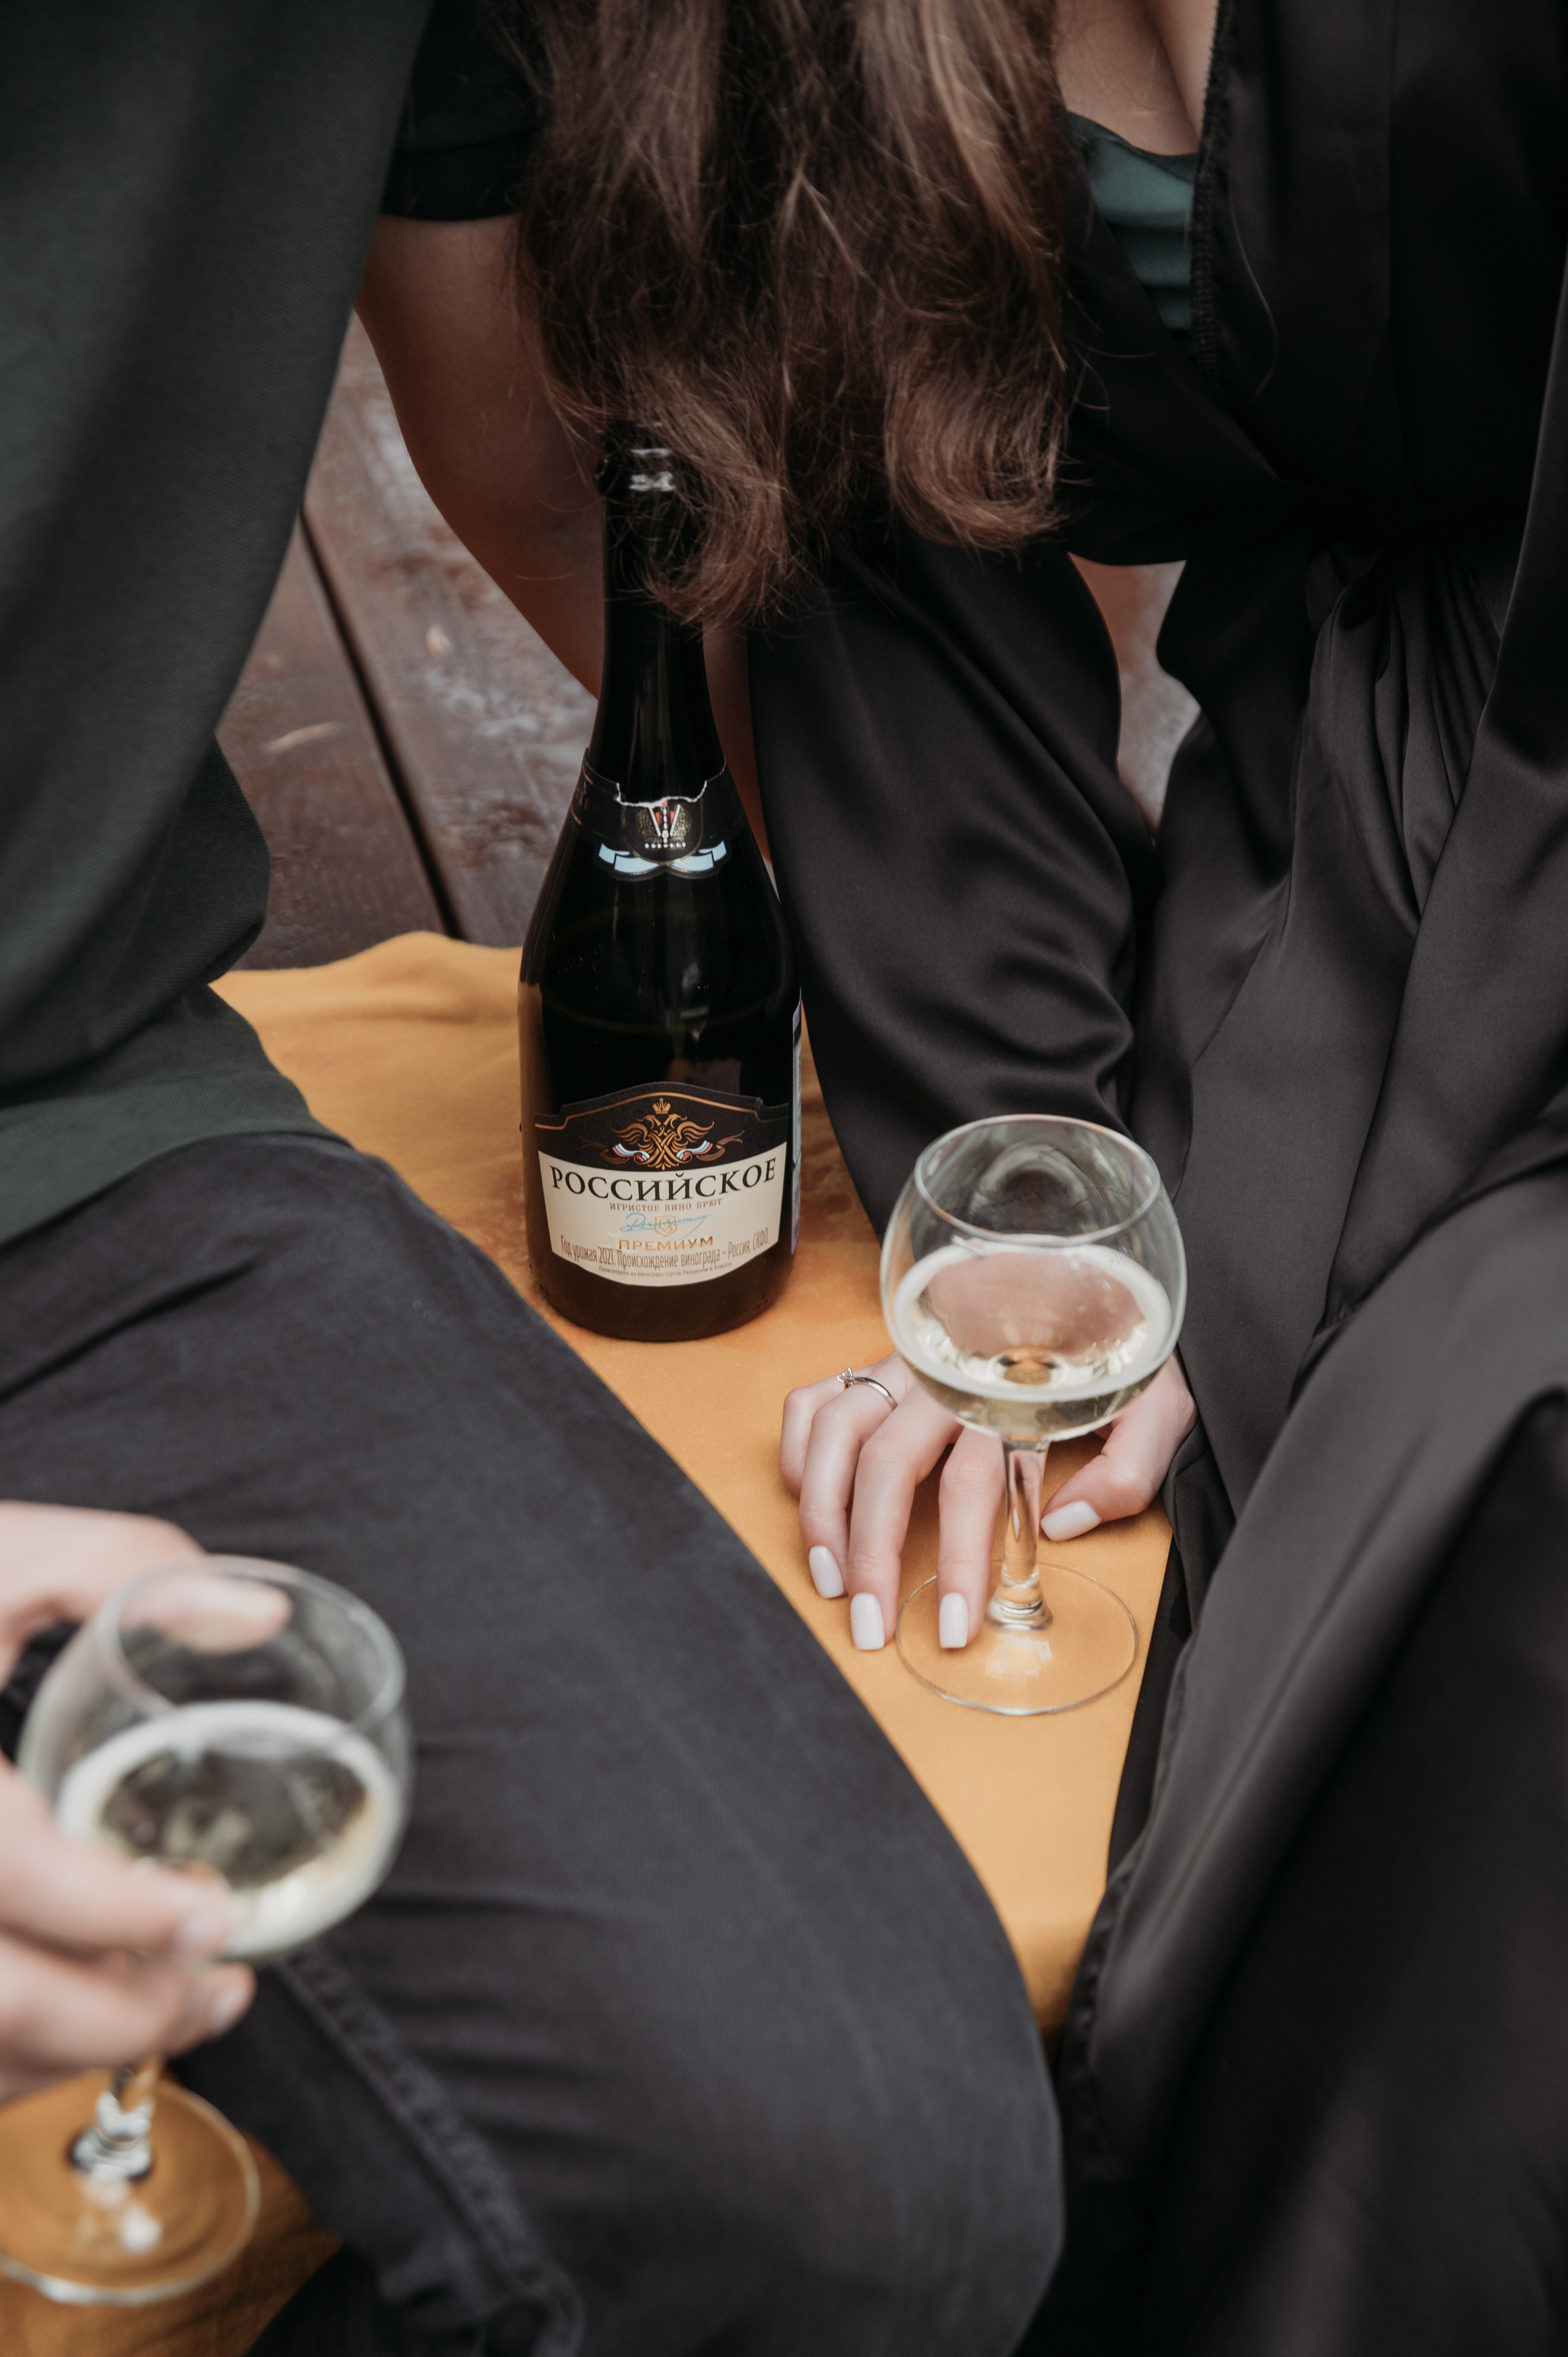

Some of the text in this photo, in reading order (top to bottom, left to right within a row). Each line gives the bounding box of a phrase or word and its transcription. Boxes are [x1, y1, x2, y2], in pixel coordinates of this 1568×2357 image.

[549, 1157, 776, 1201] РОССИЙСКОЕ
[610, 1199, 722, 1212] ИГРИСТОЕ ВИНО БРЮТ
[560, 1235, 572, 1258] Год
[573, 1244, 597, 1262] урожая
[598, 1246, 616, 1265] 2021.
[617, 1250, 678, 1270] Происхождение
[681, 1249, 720, 1267] винограда
[728, 1240, 751, 1258] Россия,
[753, 1227, 769, 1250] СКФО.
[619, 1235, 713, 1251] ПРЕМИУМ
[598, 1265, 630, 1276] Произведено
